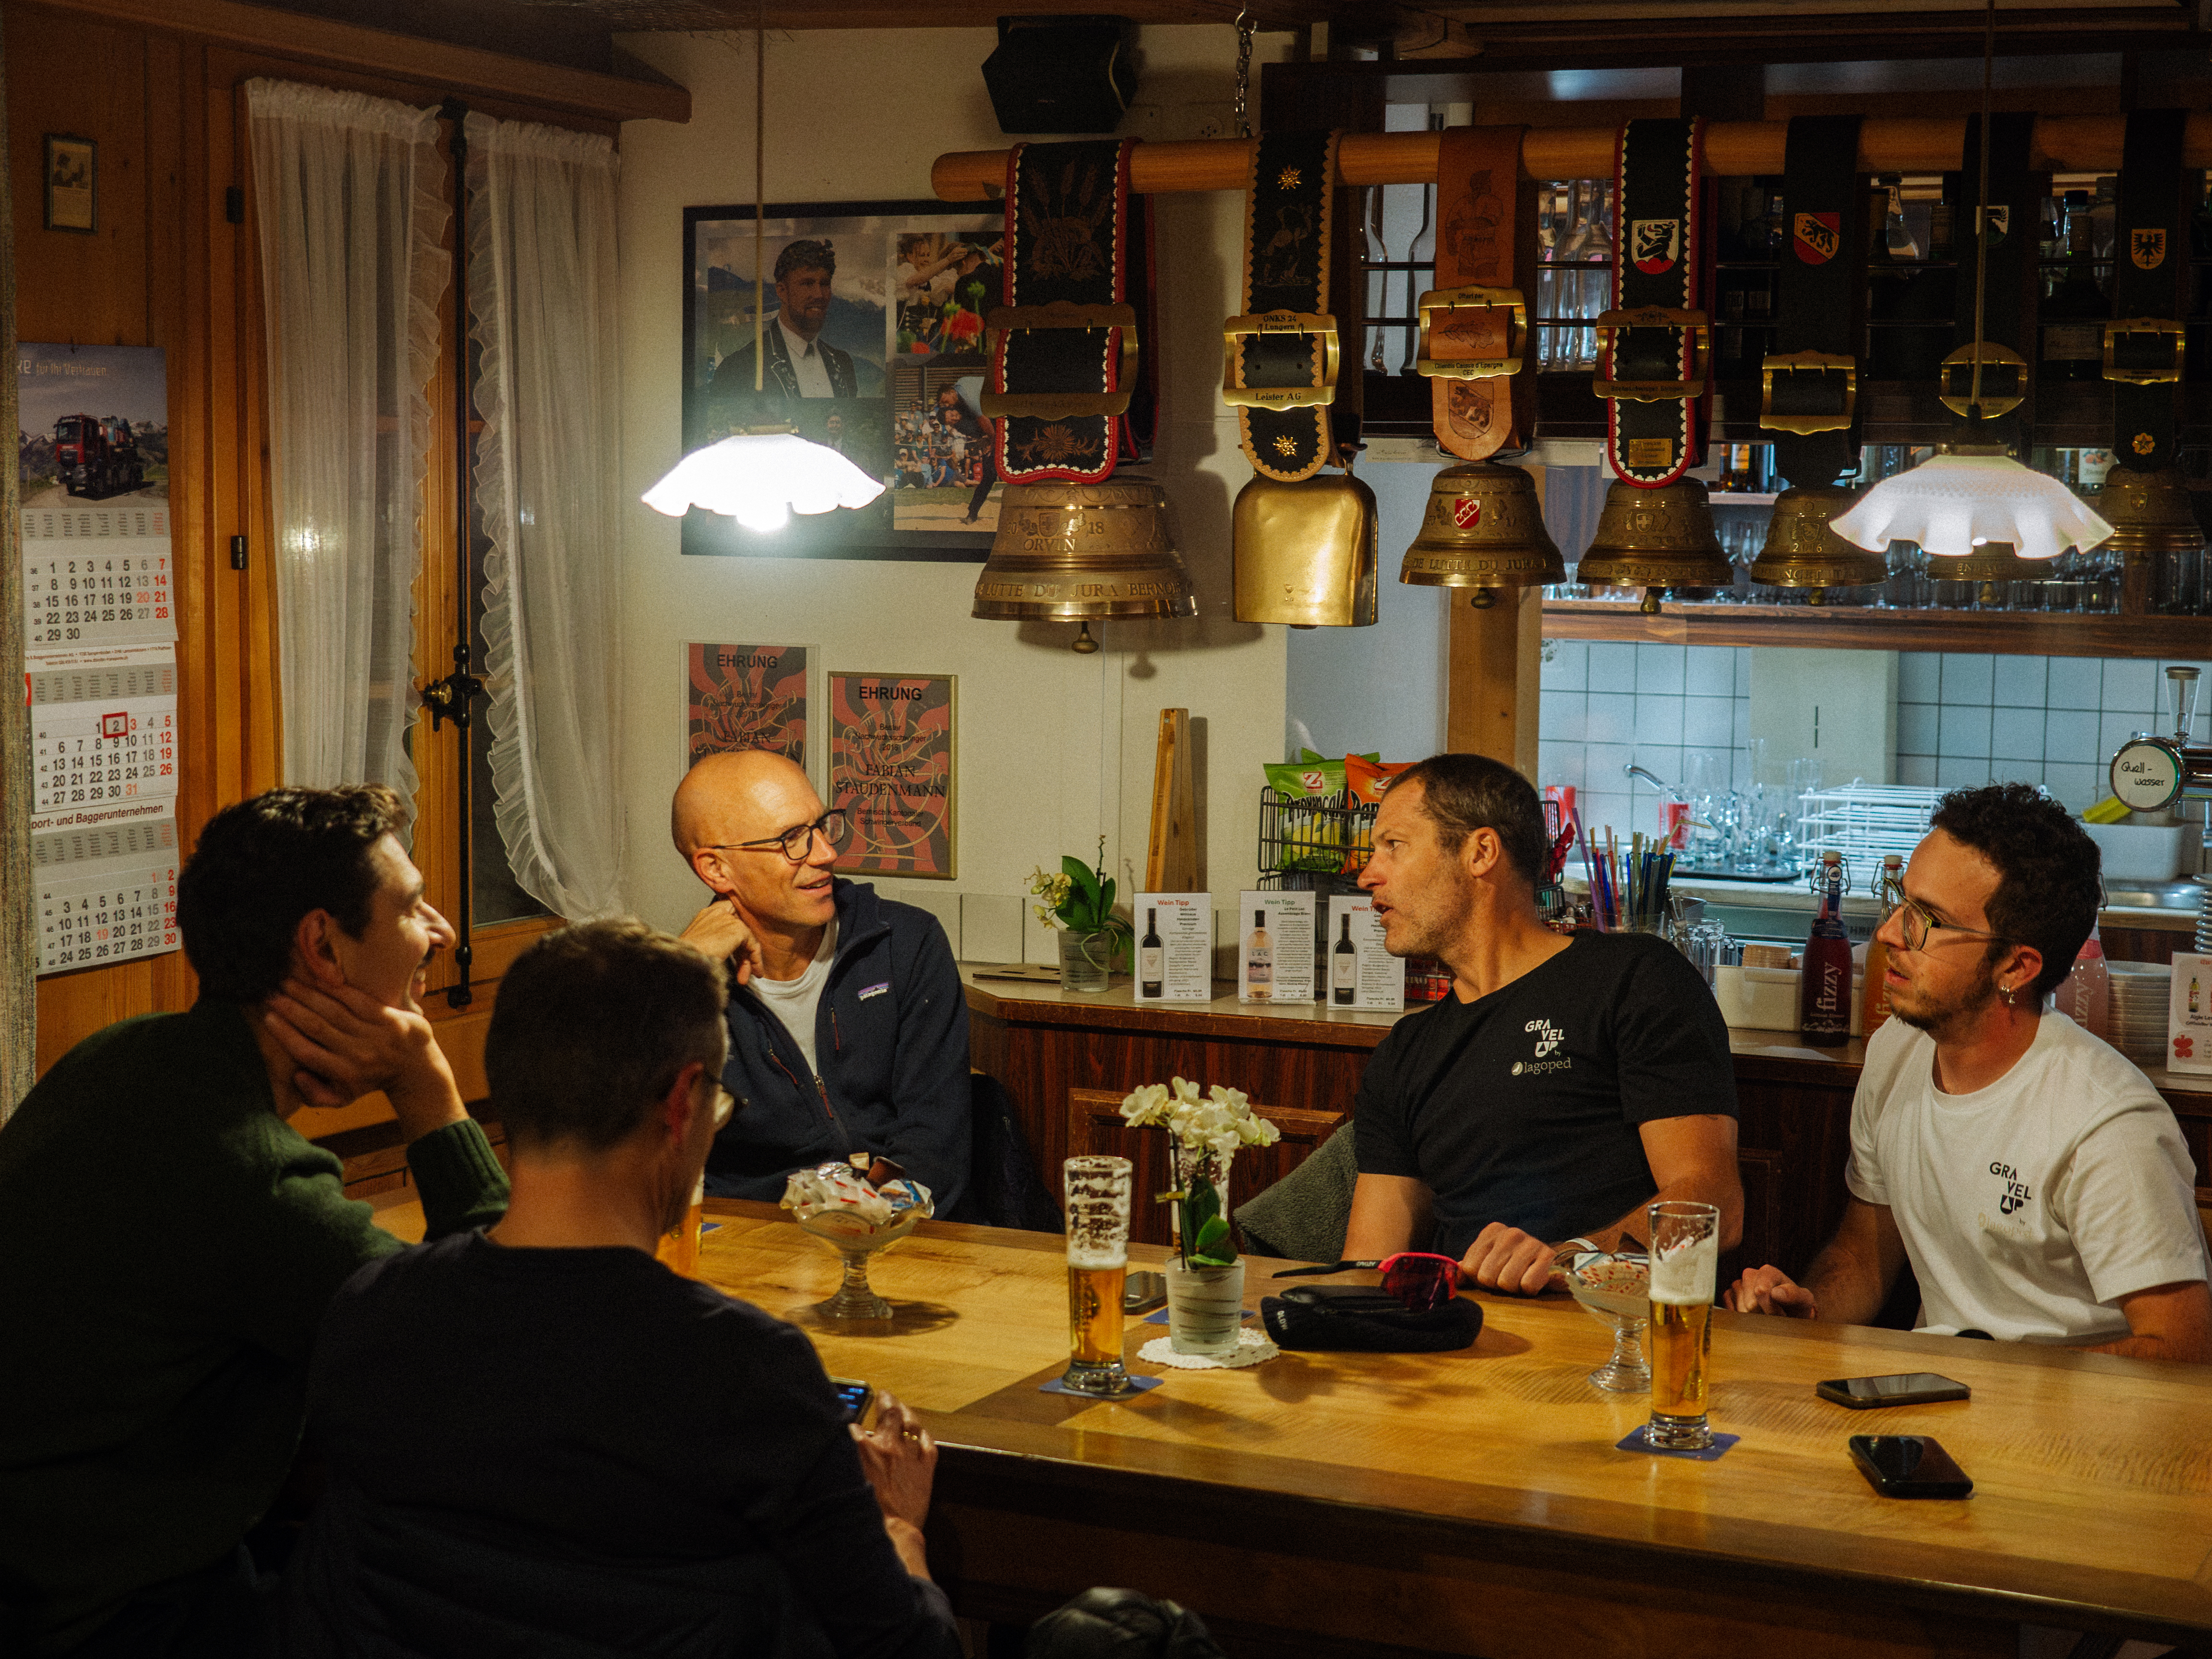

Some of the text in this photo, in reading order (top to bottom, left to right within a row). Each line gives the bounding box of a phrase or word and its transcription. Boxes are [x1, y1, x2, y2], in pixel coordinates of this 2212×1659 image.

[1255, 392, 1284, 401] Leister
[1089, 521, 1105, 534] 18
[1023, 538, 1076, 551] ORVIN
[50, 559, 165, 573] 1 2 3 4 5 6 7
[51, 575, 166, 590] 8 9 10 11 12 13 14
[1034, 584, 1059, 598] DU
[1070, 583, 1118, 597] JURA
[46, 591, 166, 607] 15 16 17 18 19 20 21
[47, 607, 168, 624] 22 23 24 25 26 27 28
[48, 628, 80, 641] 29 30
[717, 654, 778, 669] EHRUNG
[859, 686, 922, 701] EHRUNG
[96, 715, 170, 733] 1 2 3 4 5
[59, 731, 171, 753] 6 7 8 9 10 11 12
[54, 747, 171, 770] 13 14 15 16 17 18 19
[53, 763, 172, 787] 20 21 22 23 24 25 26
[866, 764, 915, 777] FABIAN
[1303, 771, 1323, 789] Z
[54, 783, 137, 804] 27 28 29 30 31
[836, 781, 945, 797] STAUDENMANN
[57, 815, 73, 826] und
[76, 805, 163, 824] Baggerunternehmen
[152, 869, 174, 883] 1 2
[63, 885, 174, 913] 3 4 5 6 7 8 9
[59, 901, 175, 930] 10 11 12 13 14 15 16
[1816, 962, 1842, 1011] fizzy
[1525, 1019, 1551, 1032] GRA
[1541, 1029, 1564, 1040] VEL
[1524, 1057, 1572, 1074] lagoped
[1990, 1162, 2017, 1181] GRA
[2008, 1181, 2032, 1200] VEL
